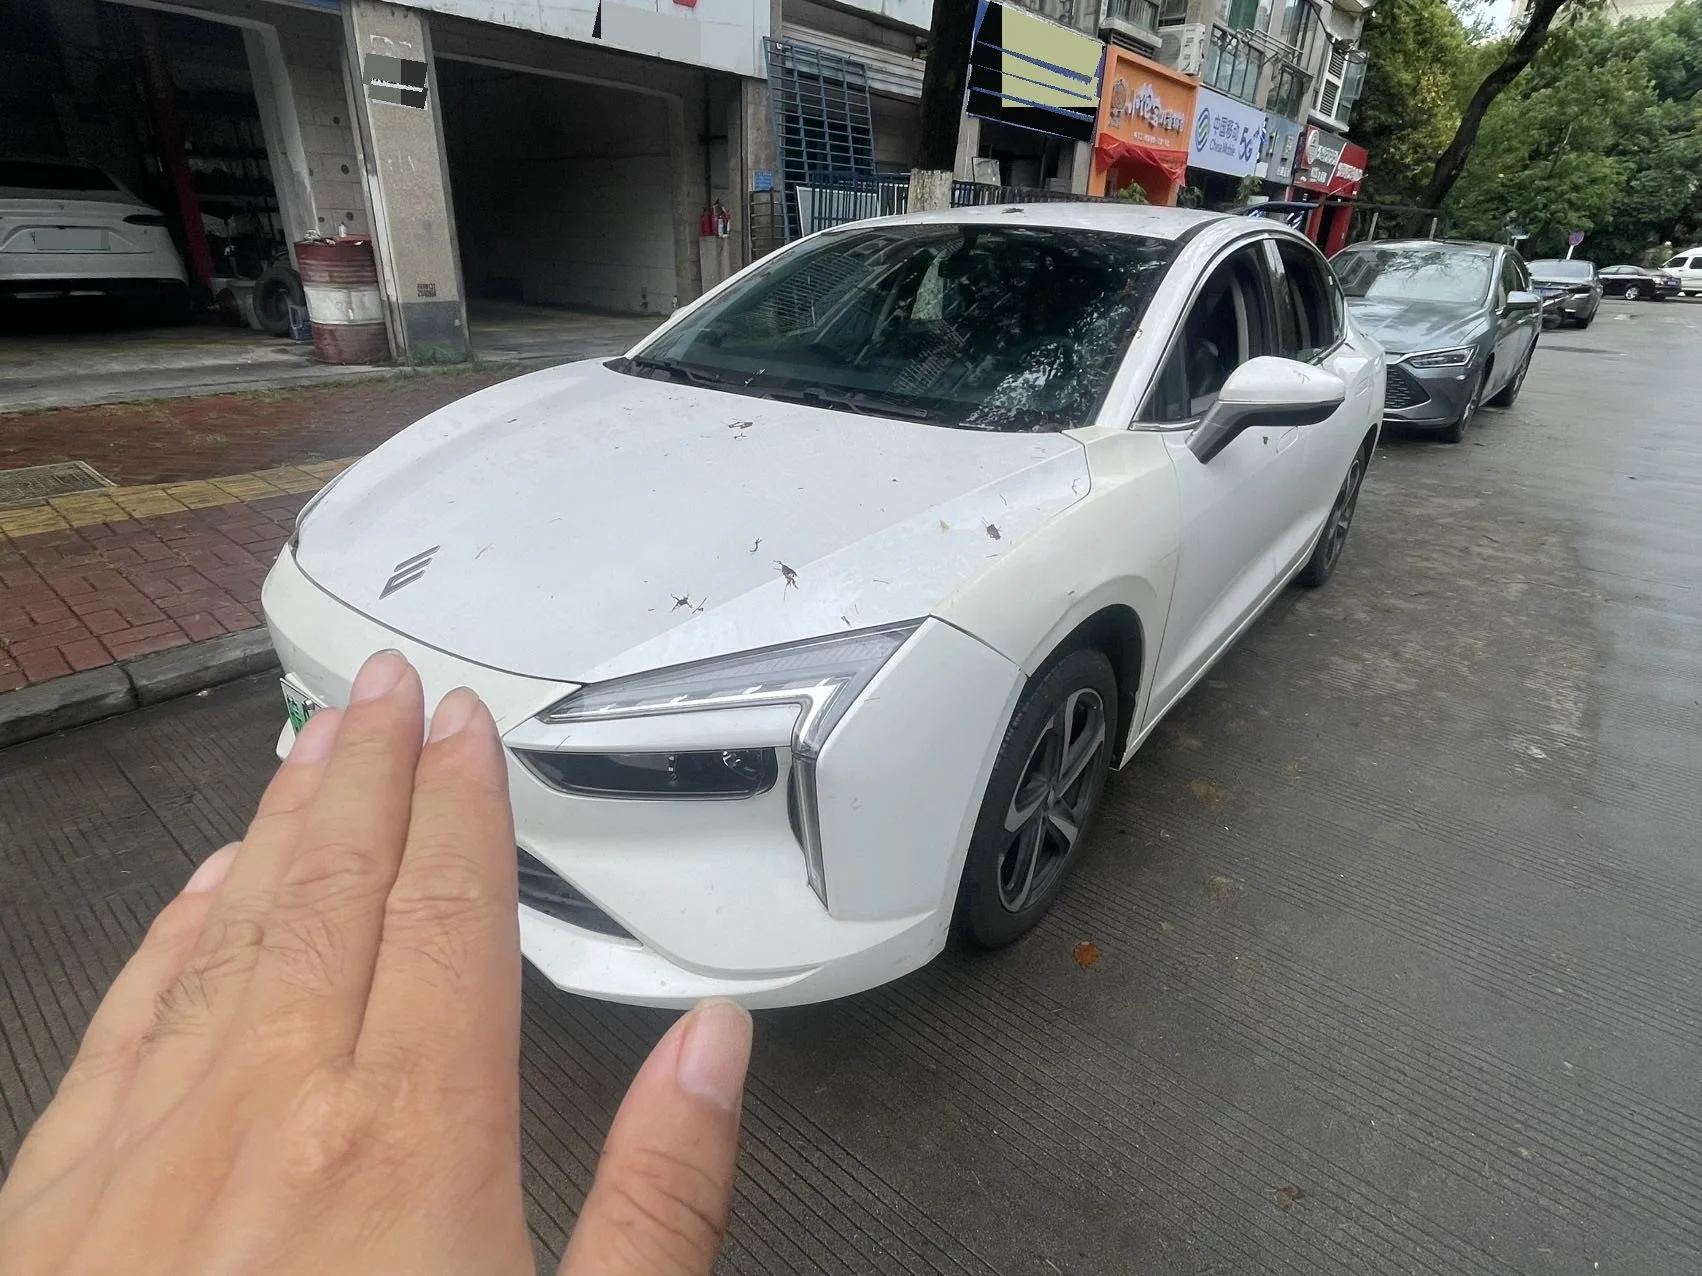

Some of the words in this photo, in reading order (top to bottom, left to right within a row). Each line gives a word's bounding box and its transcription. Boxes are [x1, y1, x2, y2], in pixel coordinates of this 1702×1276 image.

[1213, 114, 1240, 141] 中国移动
[1209, 138, 1222, 153] China
[1223, 142, 1235, 156] Mobile
[1239, 127, 1253, 162] 5G
